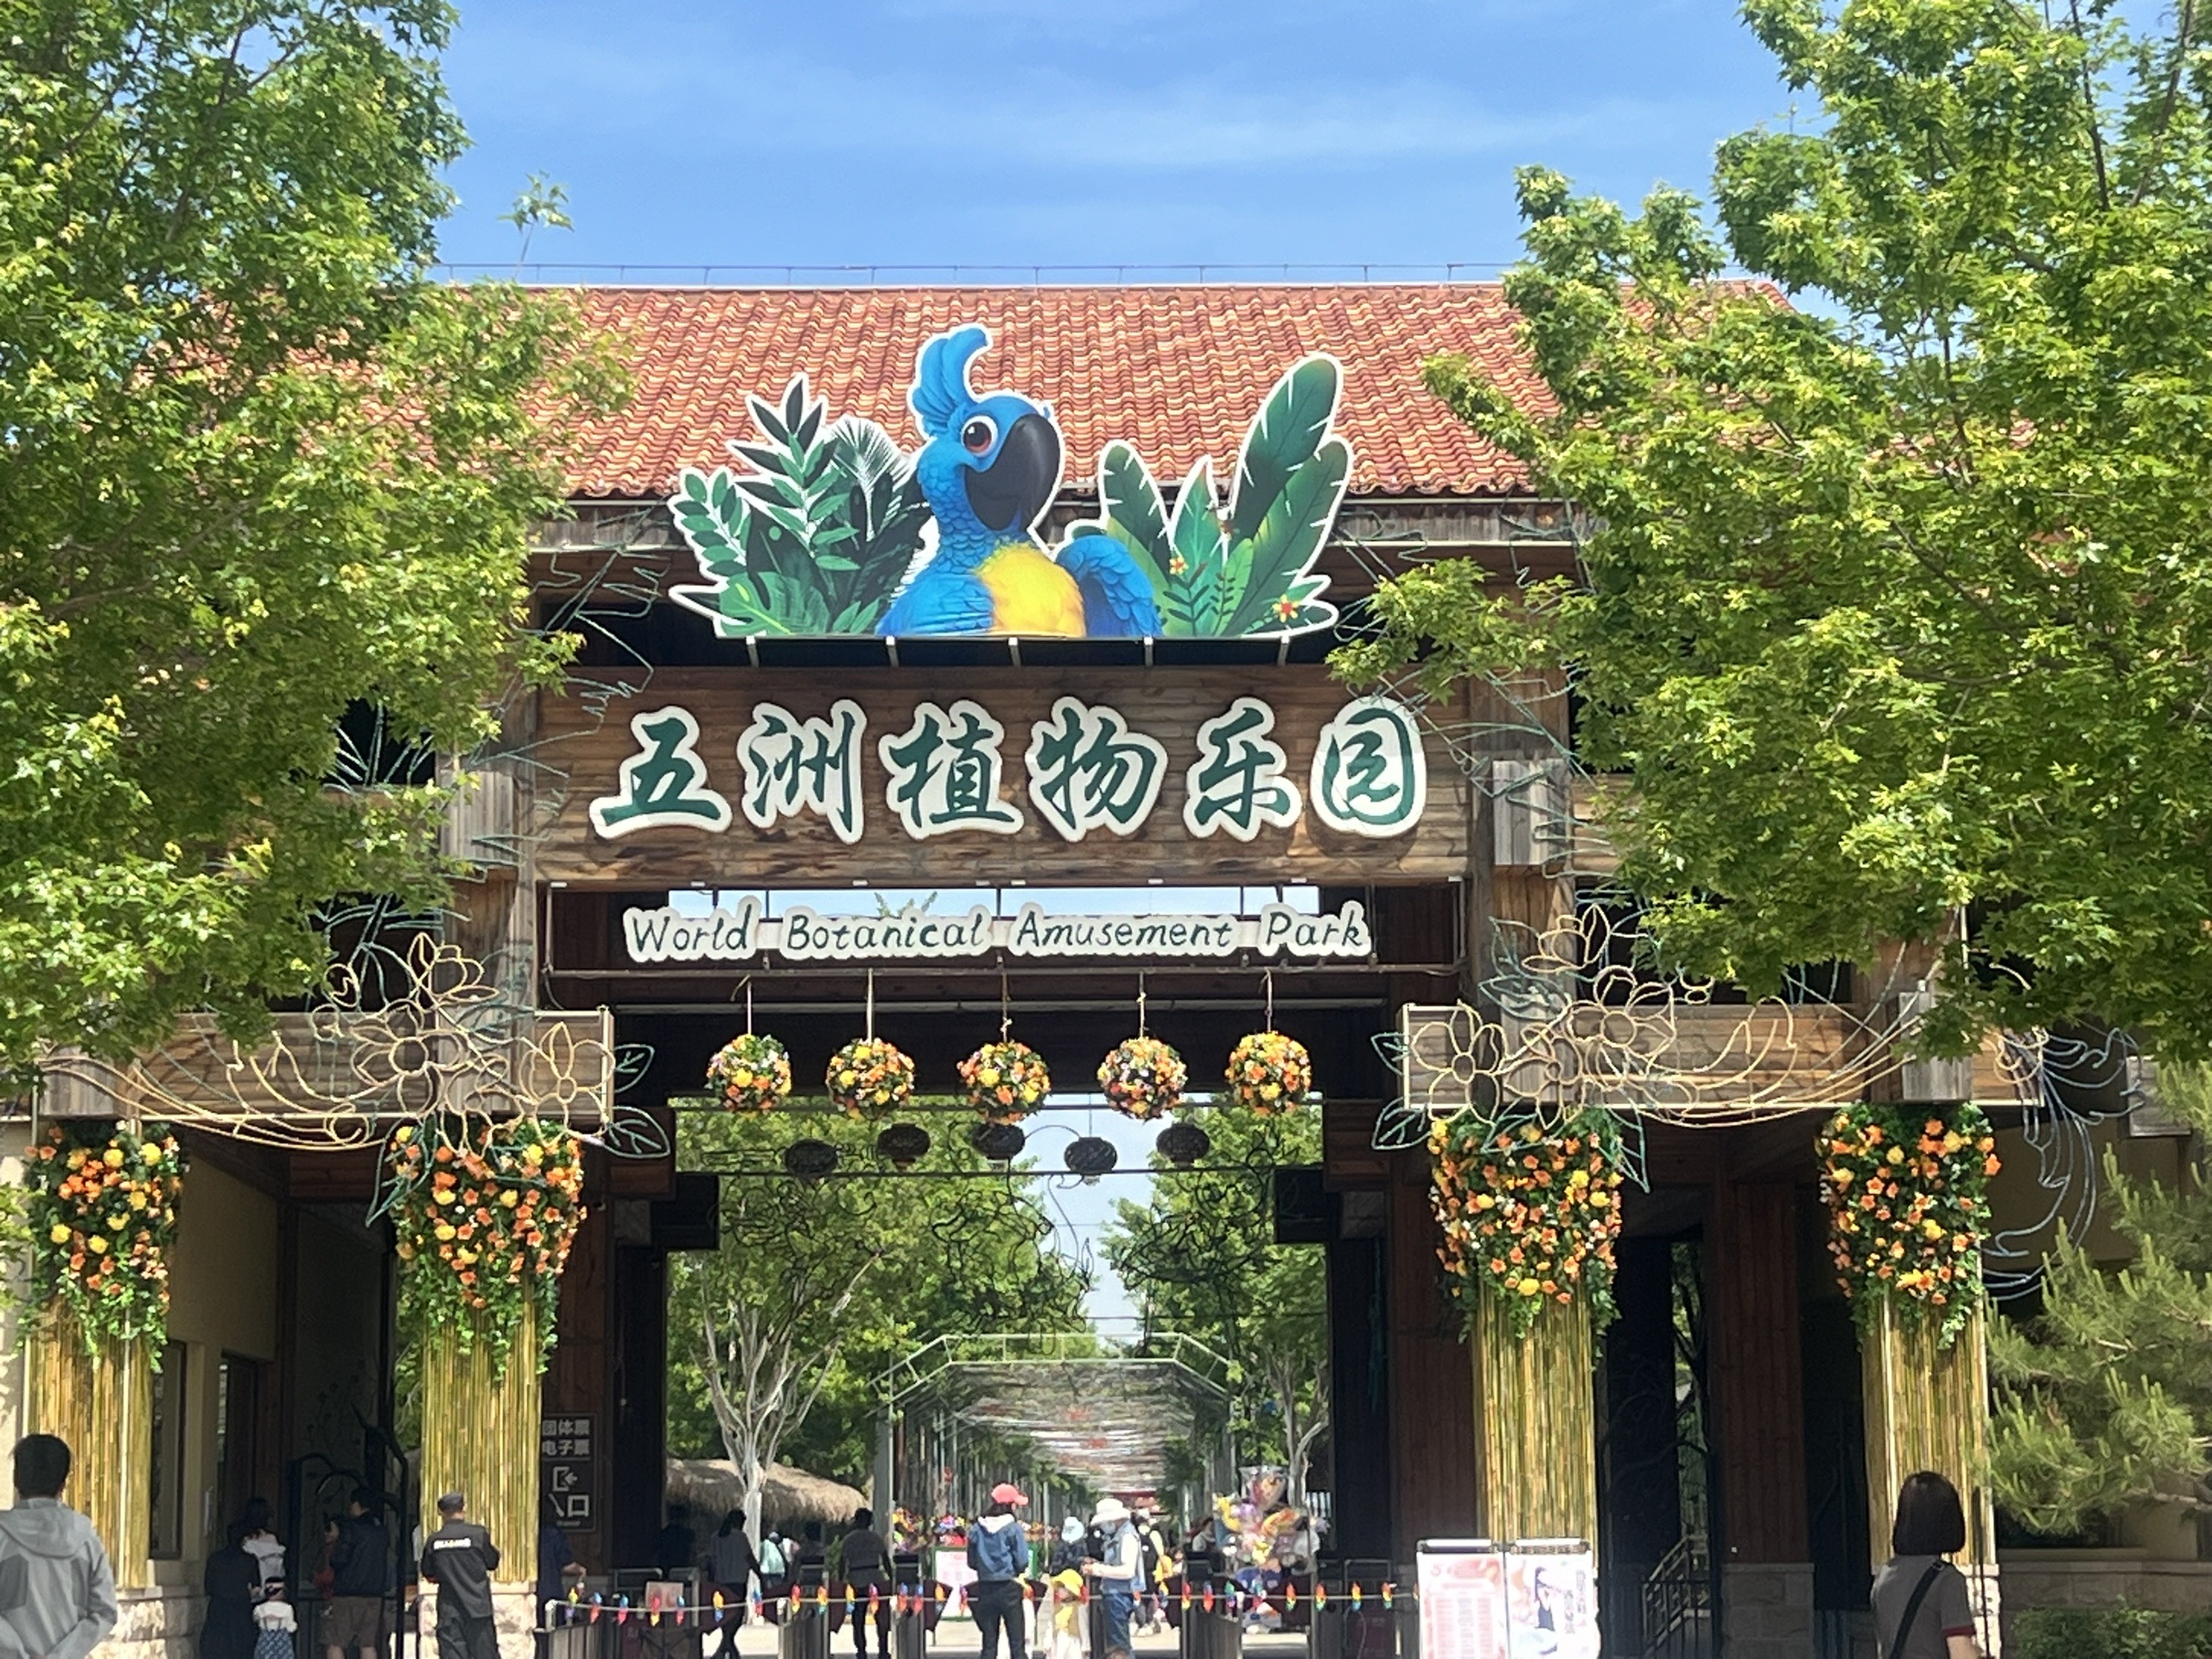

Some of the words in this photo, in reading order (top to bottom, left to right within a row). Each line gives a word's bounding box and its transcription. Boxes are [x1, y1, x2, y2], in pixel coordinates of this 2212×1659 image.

[598, 703, 1417, 836] 五洲植物乐园
[631, 902, 753, 952] World
[785, 912, 985, 951] Botanical
[1015, 909, 1234, 949] Amusement
[1264, 909, 1363, 948] Park
